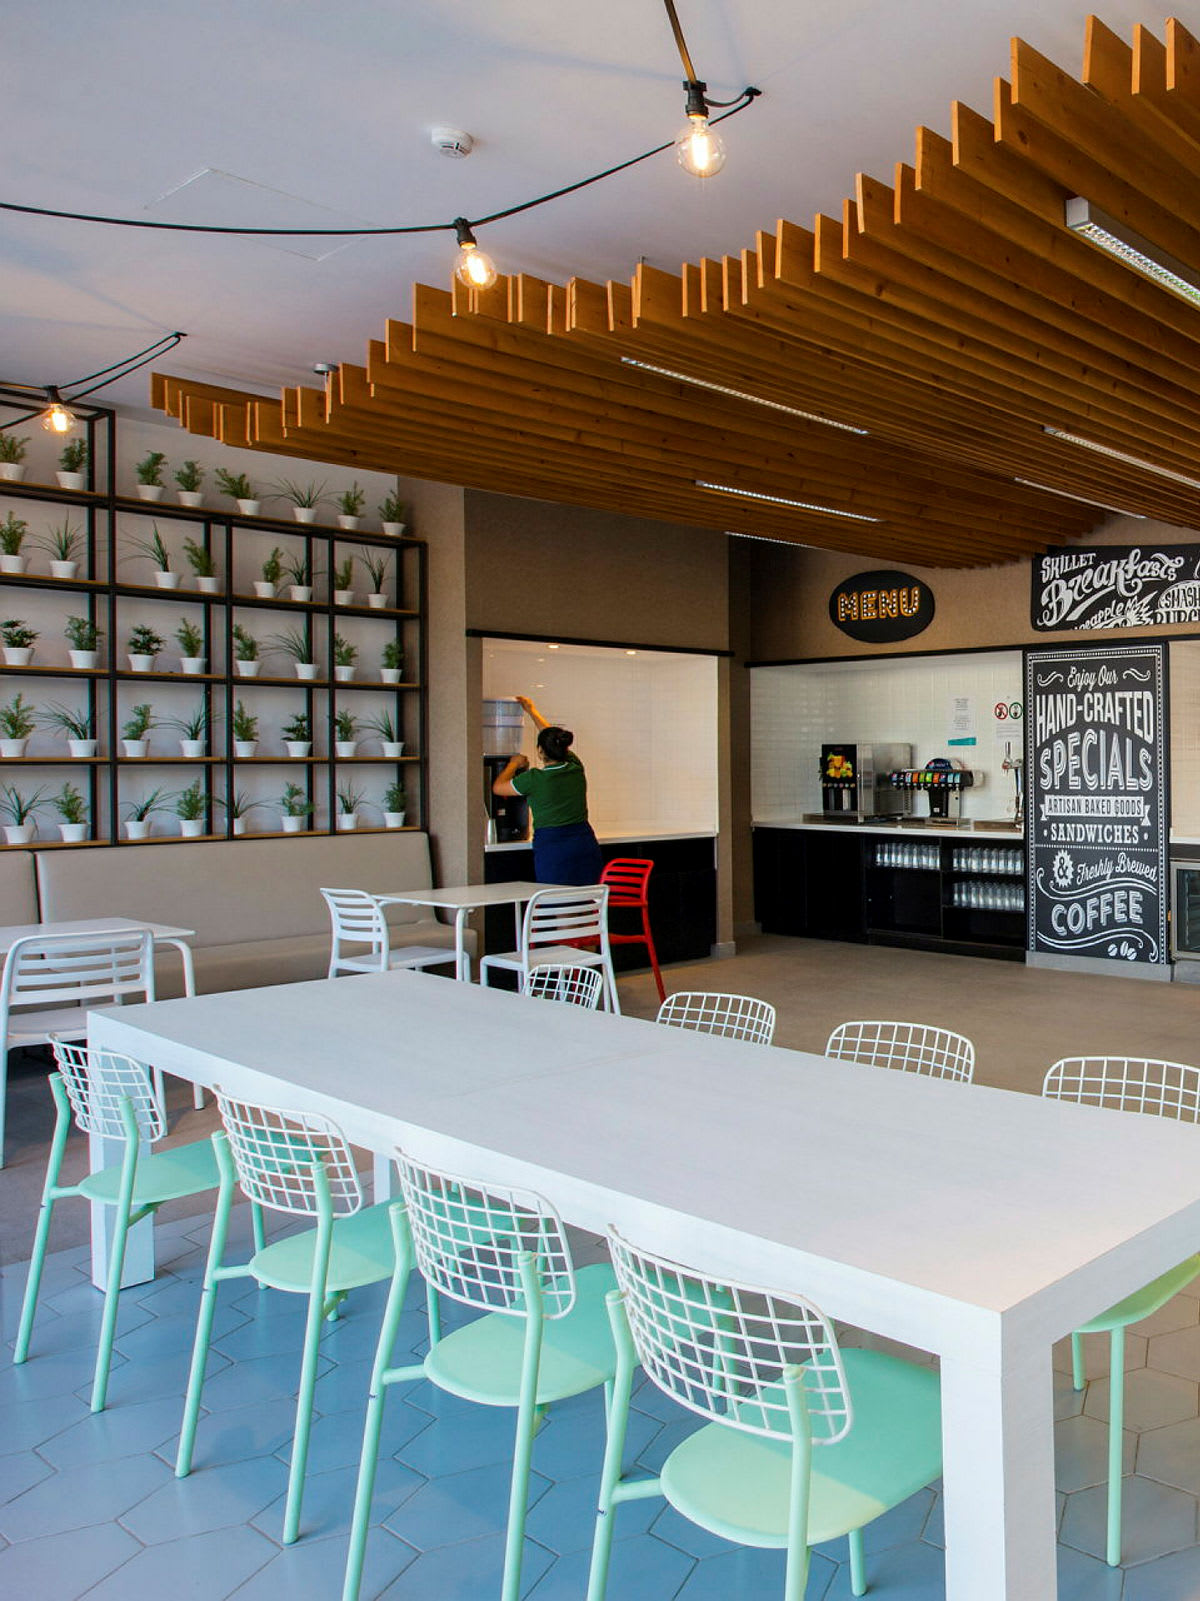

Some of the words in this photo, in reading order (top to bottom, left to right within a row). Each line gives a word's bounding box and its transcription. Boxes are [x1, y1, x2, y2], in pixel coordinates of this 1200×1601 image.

[1040, 553, 1096, 583] SKILLET
[838, 586, 920, 621] MENU
[1067, 666, 1096, 691] Enjoy
[1098, 665, 1118, 685] Our
[1036, 691, 1154, 748] HAND-CRAFTED
[1040, 729, 1153, 791] SPECIALS
[1048, 798, 1082, 814] ARTISAN
[1085, 798, 1112, 815] BAKED
[1114, 799, 1142, 817] GOODS
[1051, 823, 1139, 844] SANDWICHES
[1058, 858, 1069, 878] &
[1077, 858, 1113, 885] Freshly
[1115, 852, 1158, 882] Brewed
[1051, 890, 1143, 936] COFFEE
